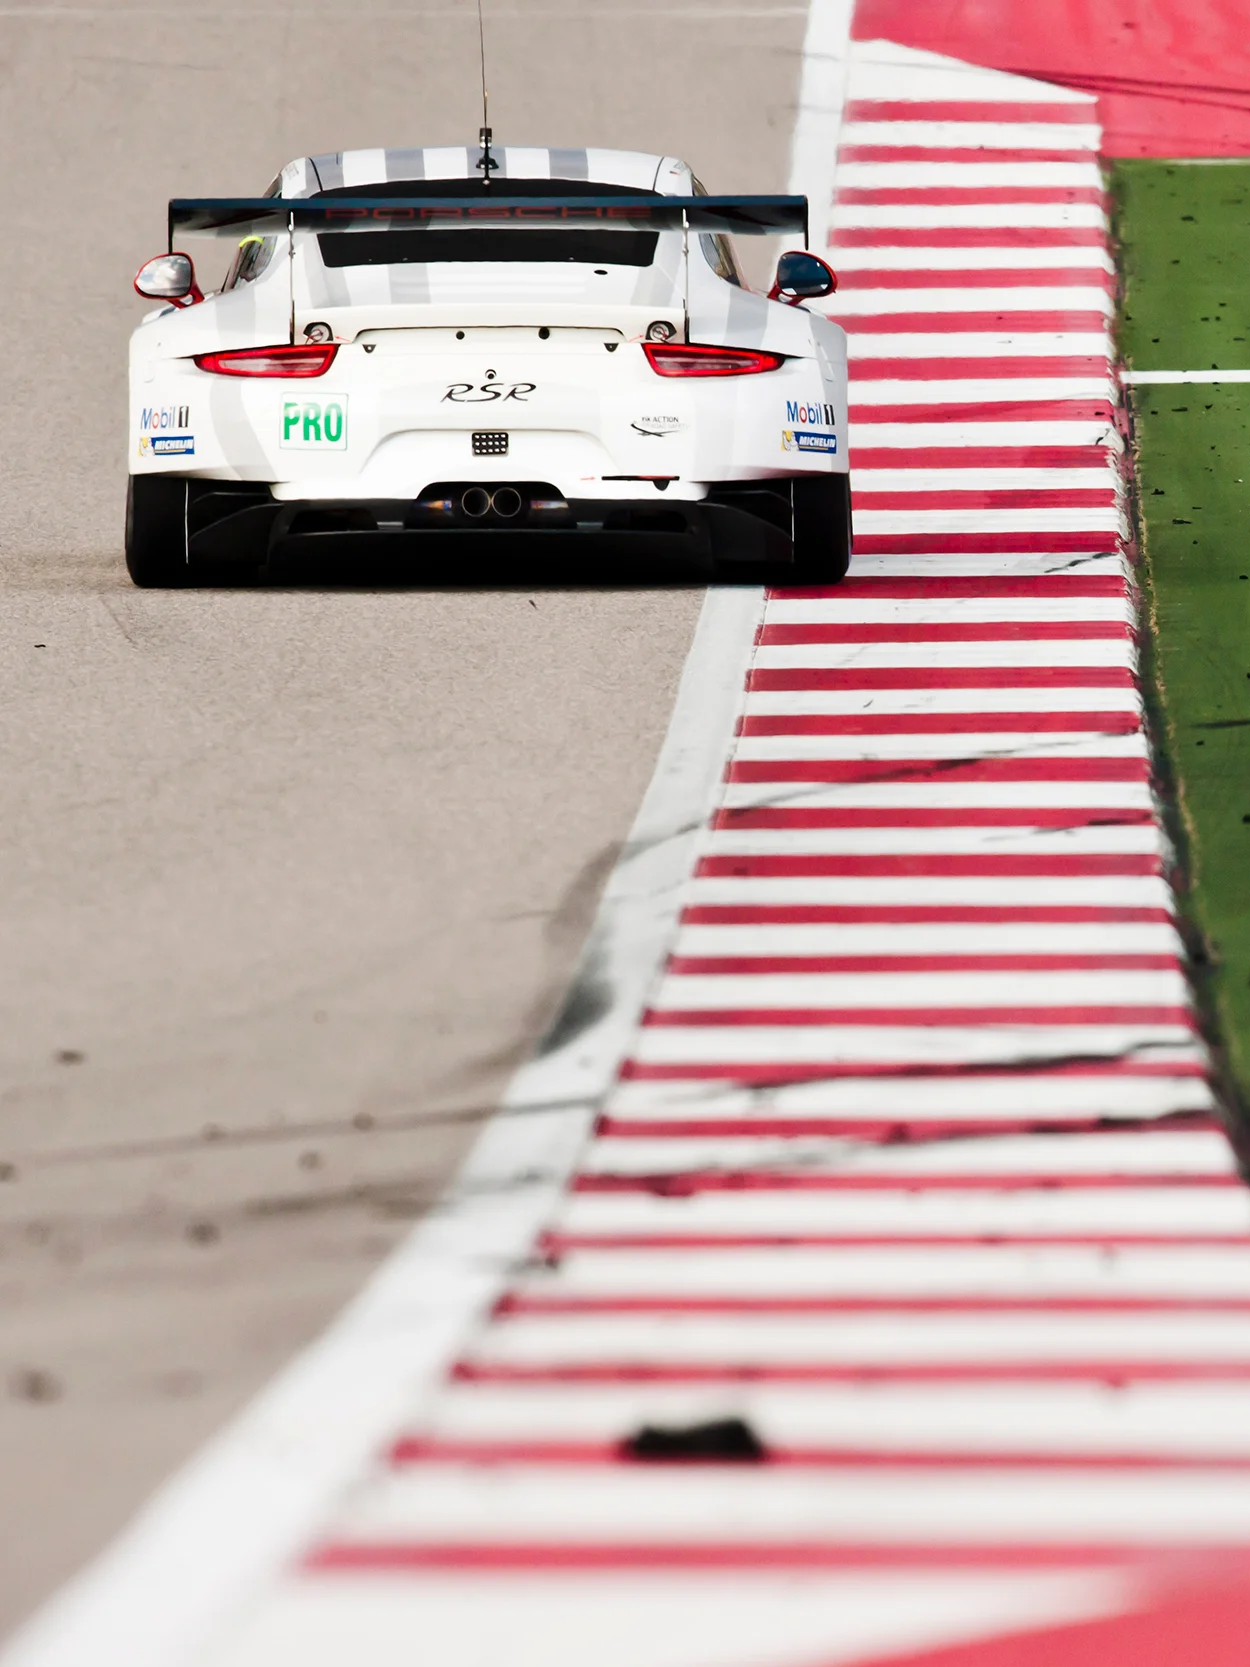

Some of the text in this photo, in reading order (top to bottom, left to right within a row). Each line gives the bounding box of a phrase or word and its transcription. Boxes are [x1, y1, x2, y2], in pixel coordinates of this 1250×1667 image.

[326, 206, 651, 219] PORSCHE
[440, 382, 537, 402] RSR
[140, 405, 190, 430] Mobil 1
[283, 402, 342, 442] PRO
[786, 400, 836, 426] Mobil 1
[154, 438, 194, 450] MICHELIN
[799, 435, 836, 448] MICHELIN
